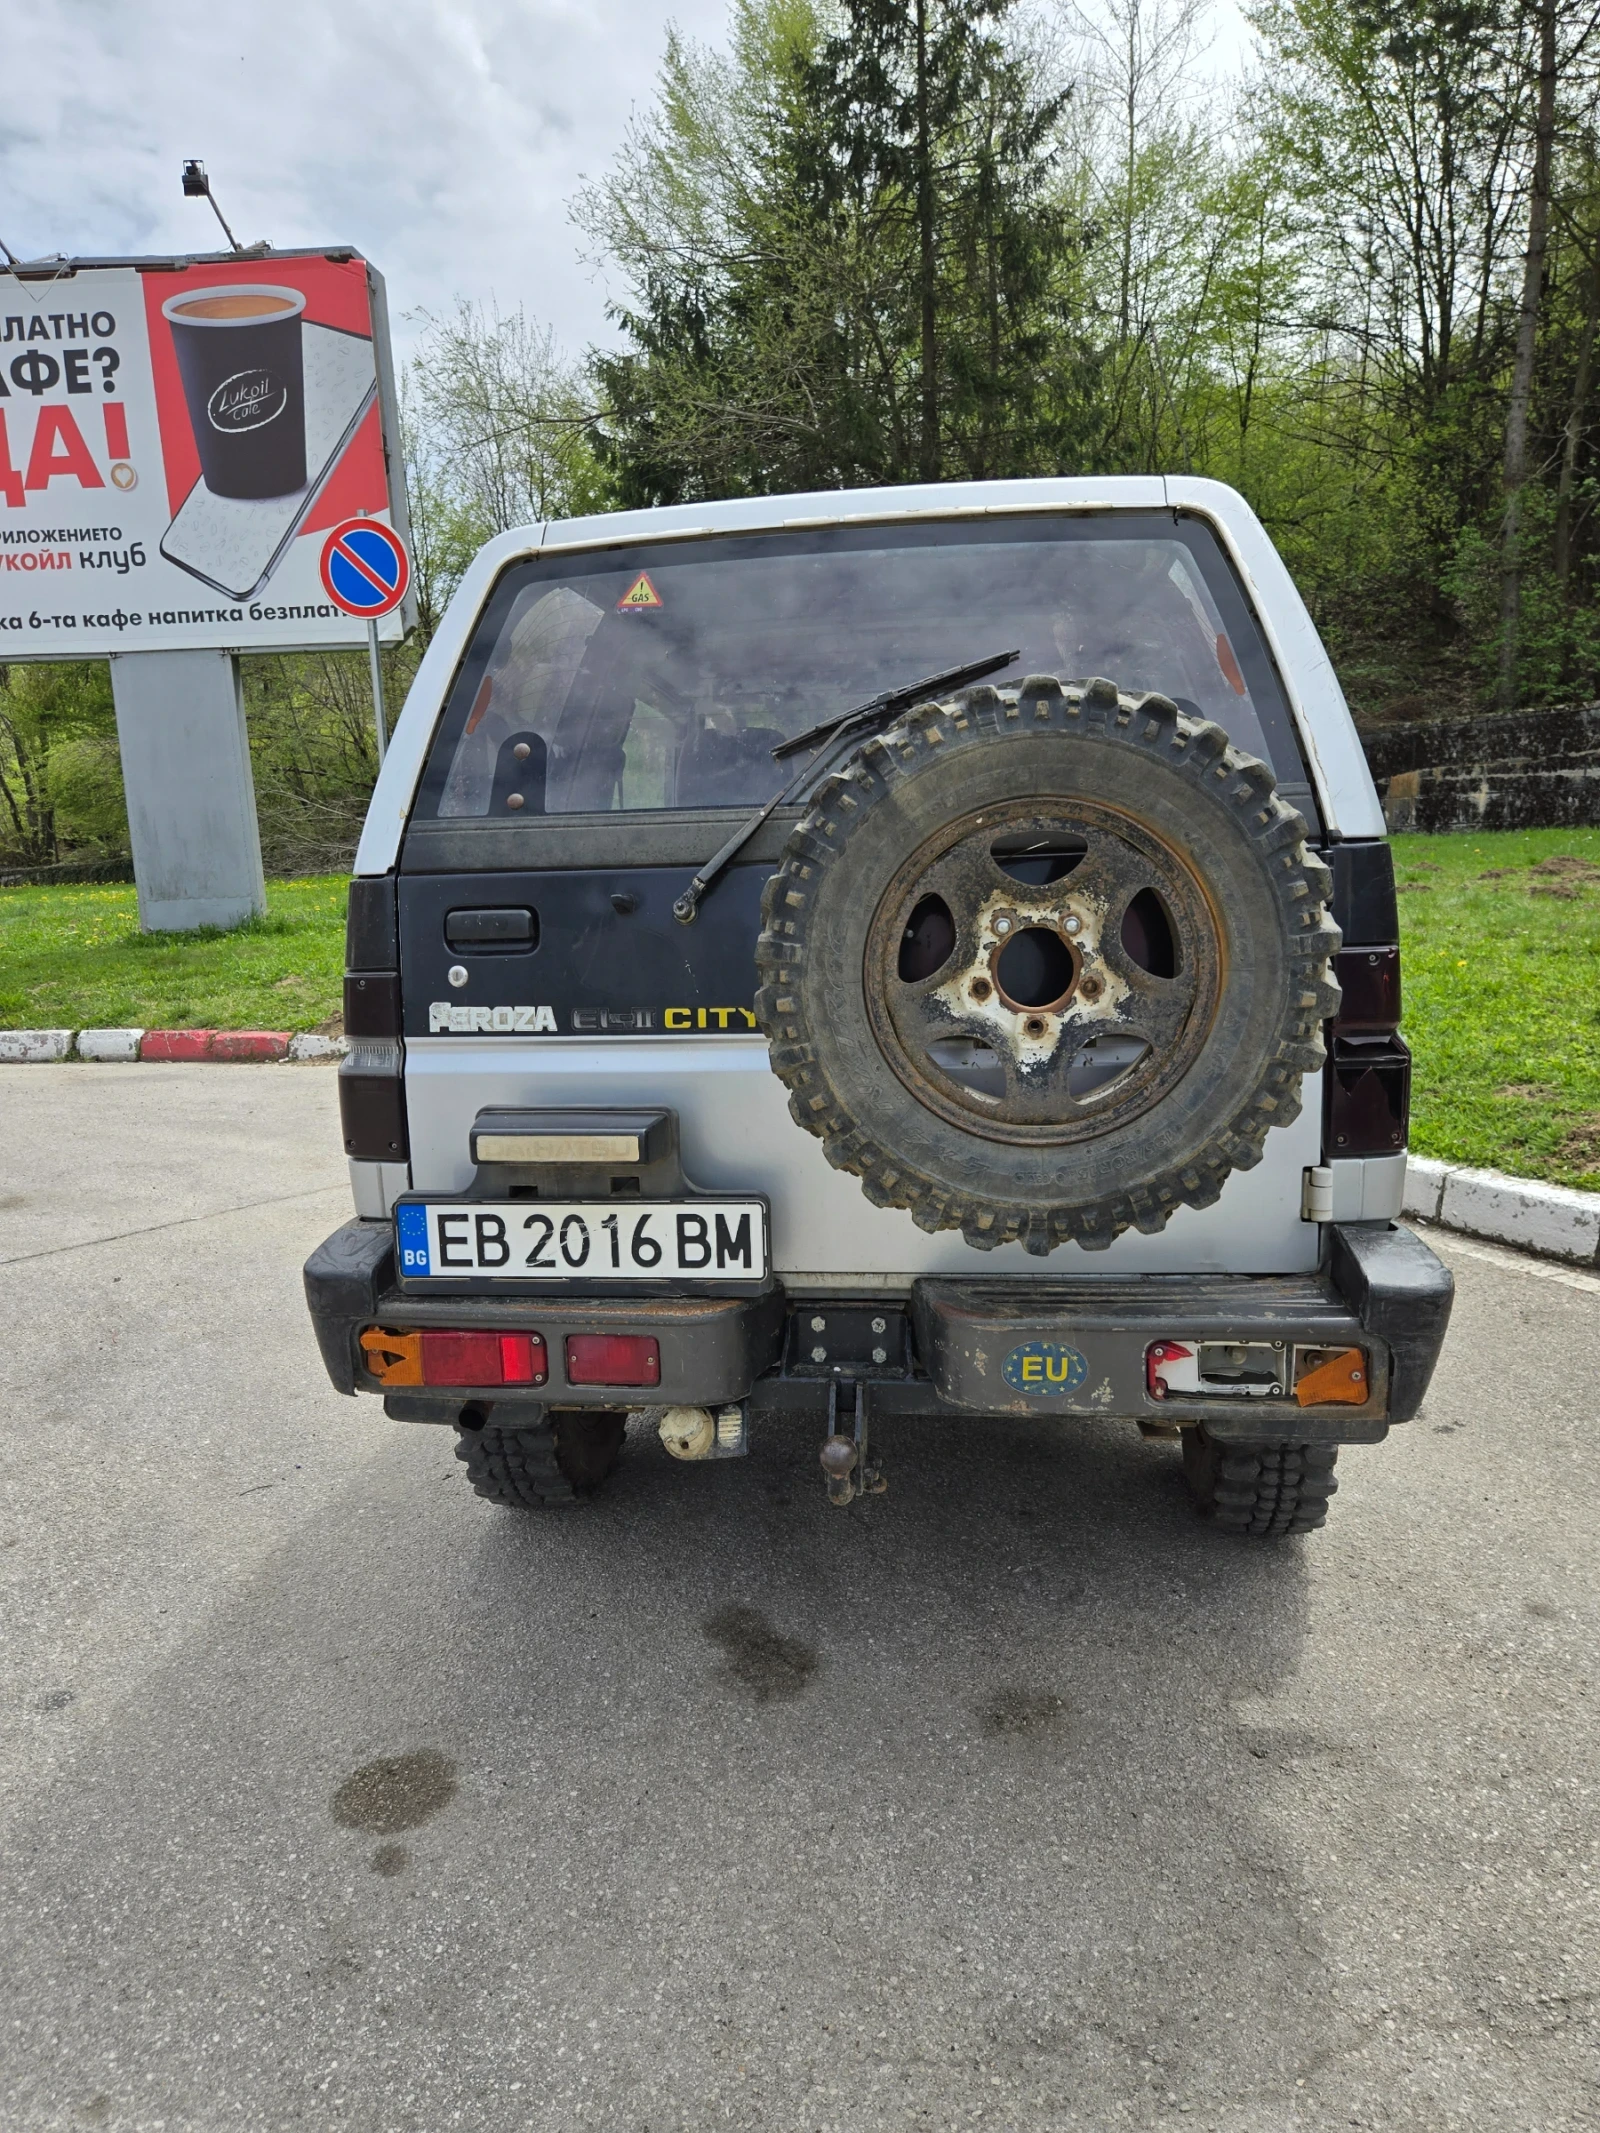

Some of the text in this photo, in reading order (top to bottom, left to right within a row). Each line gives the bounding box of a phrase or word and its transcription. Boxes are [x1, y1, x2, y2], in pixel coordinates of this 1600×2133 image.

[0, 311, 116, 342] ЛАТНО
[0, 346, 120, 397] ФЕ?
[219, 378, 269, 412] Lukoil
[0, 402, 131, 507] А!
[0, 527, 122, 544] ИЛОЖЕНИЕТО
[79, 541, 146, 574] клуб
[631, 592, 649, 602] GAS
[28, 610, 77, 630] 6-та
[82, 608, 142, 631] кафе
[148, 608, 243, 625] напитка
[249, 602, 347, 621] безплат
[664, 1007, 757, 1029] CITY
[404, 1250, 427, 1266] BG
[1022, 1356, 1068, 1381] EU
